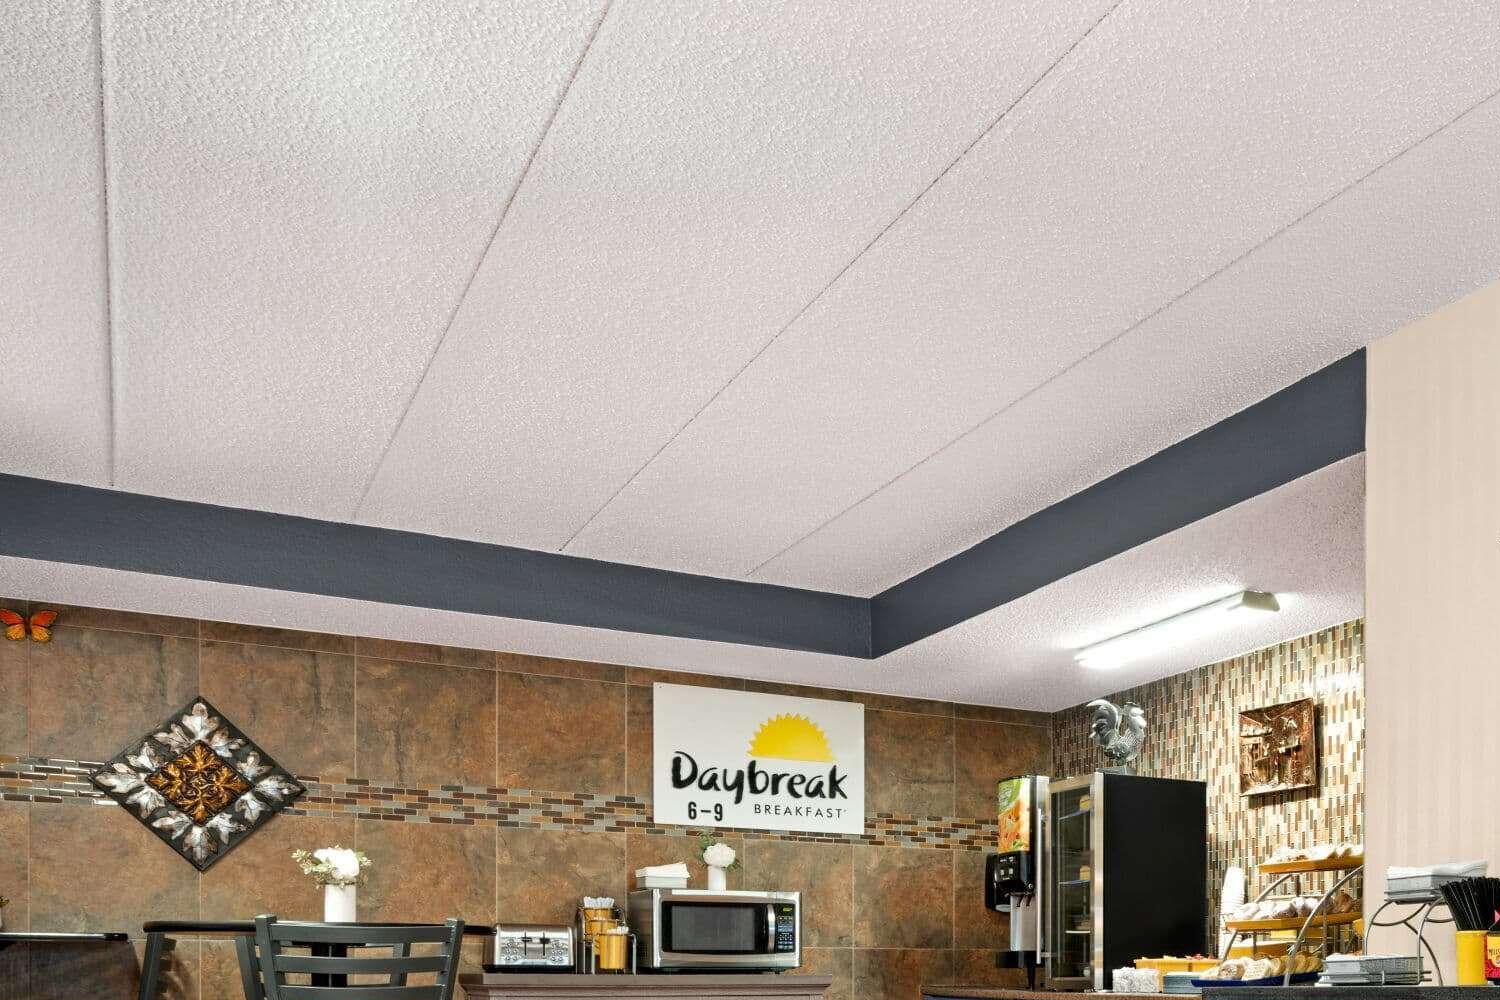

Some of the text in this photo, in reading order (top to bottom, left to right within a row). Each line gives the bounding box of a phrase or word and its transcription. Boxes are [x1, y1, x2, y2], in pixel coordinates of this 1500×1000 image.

[671, 751, 848, 804] Daybreak
[687, 801, 843, 821] 6-9 BREAKFAST
